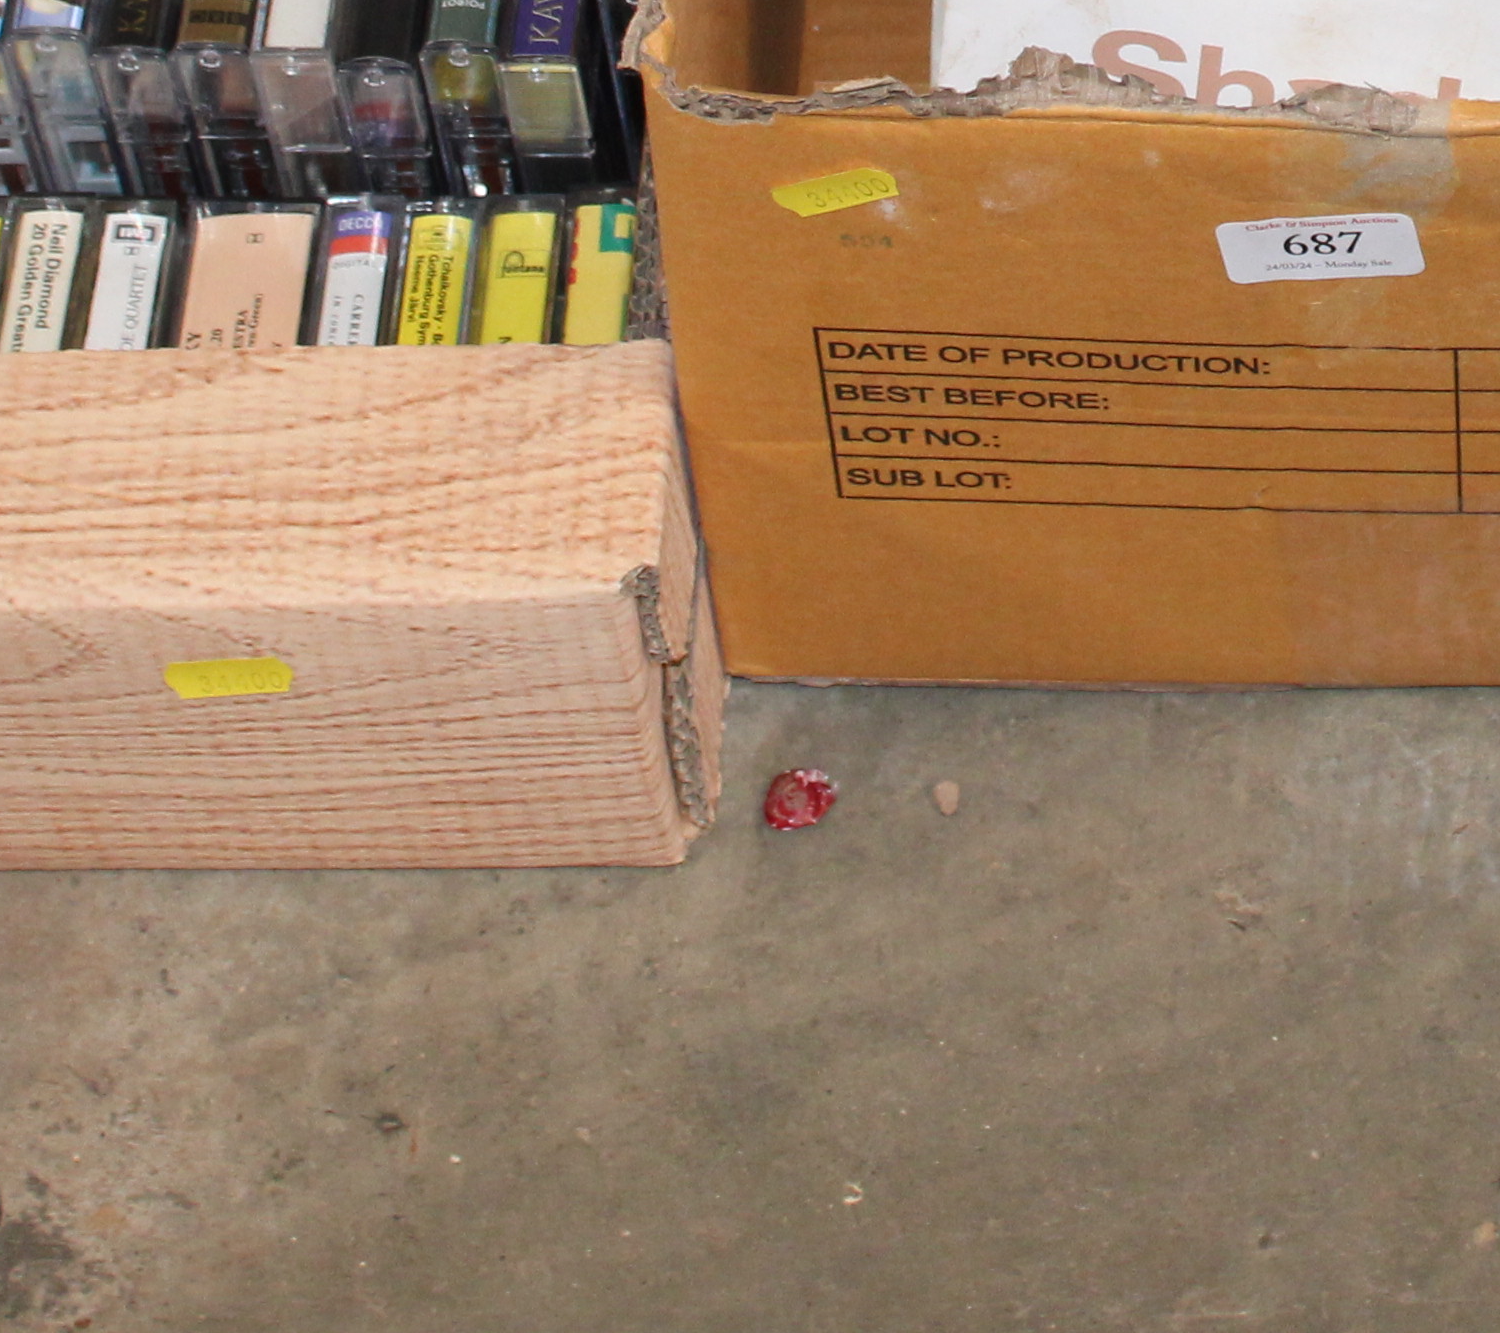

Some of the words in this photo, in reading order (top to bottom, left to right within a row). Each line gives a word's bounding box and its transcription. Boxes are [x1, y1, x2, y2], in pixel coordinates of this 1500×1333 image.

[442, 0, 486, 10] POIROT
[806, 177, 891, 210] 34400
[31, 223, 49, 242] 20
[49, 223, 69, 254] Neil
[1246, 222, 1281, 232] Clarke
[1299, 219, 1347, 229] Simpson
[1283, 231, 1362, 255] 687
[21, 244, 45, 301] Golden
[1325, 260, 1367, 270] Monday
[1371, 259, 1392, 267] Sale
[34, 257, 65, 329] Diamond
[123, 264, 149, 329] QUARTET
[422, 254, 443, 316] Gothenburg
[436, 256, 456, 320] Tchaikovsky
[828, 340, 928, 363] DATE
[939, 344, 991, 365] OF
[1002, 348, 1271, 376] PRODUCTION:
[833, 383, 933, 405] BEST
[944, 386, 1109, 412] BEFORE:
[840, 426, 914, 446] LOT
[925, 427, 1001, 449] NO.:
[847, 467, 924, 488] SUB
[933, 468, 1012, 490] LOT:
